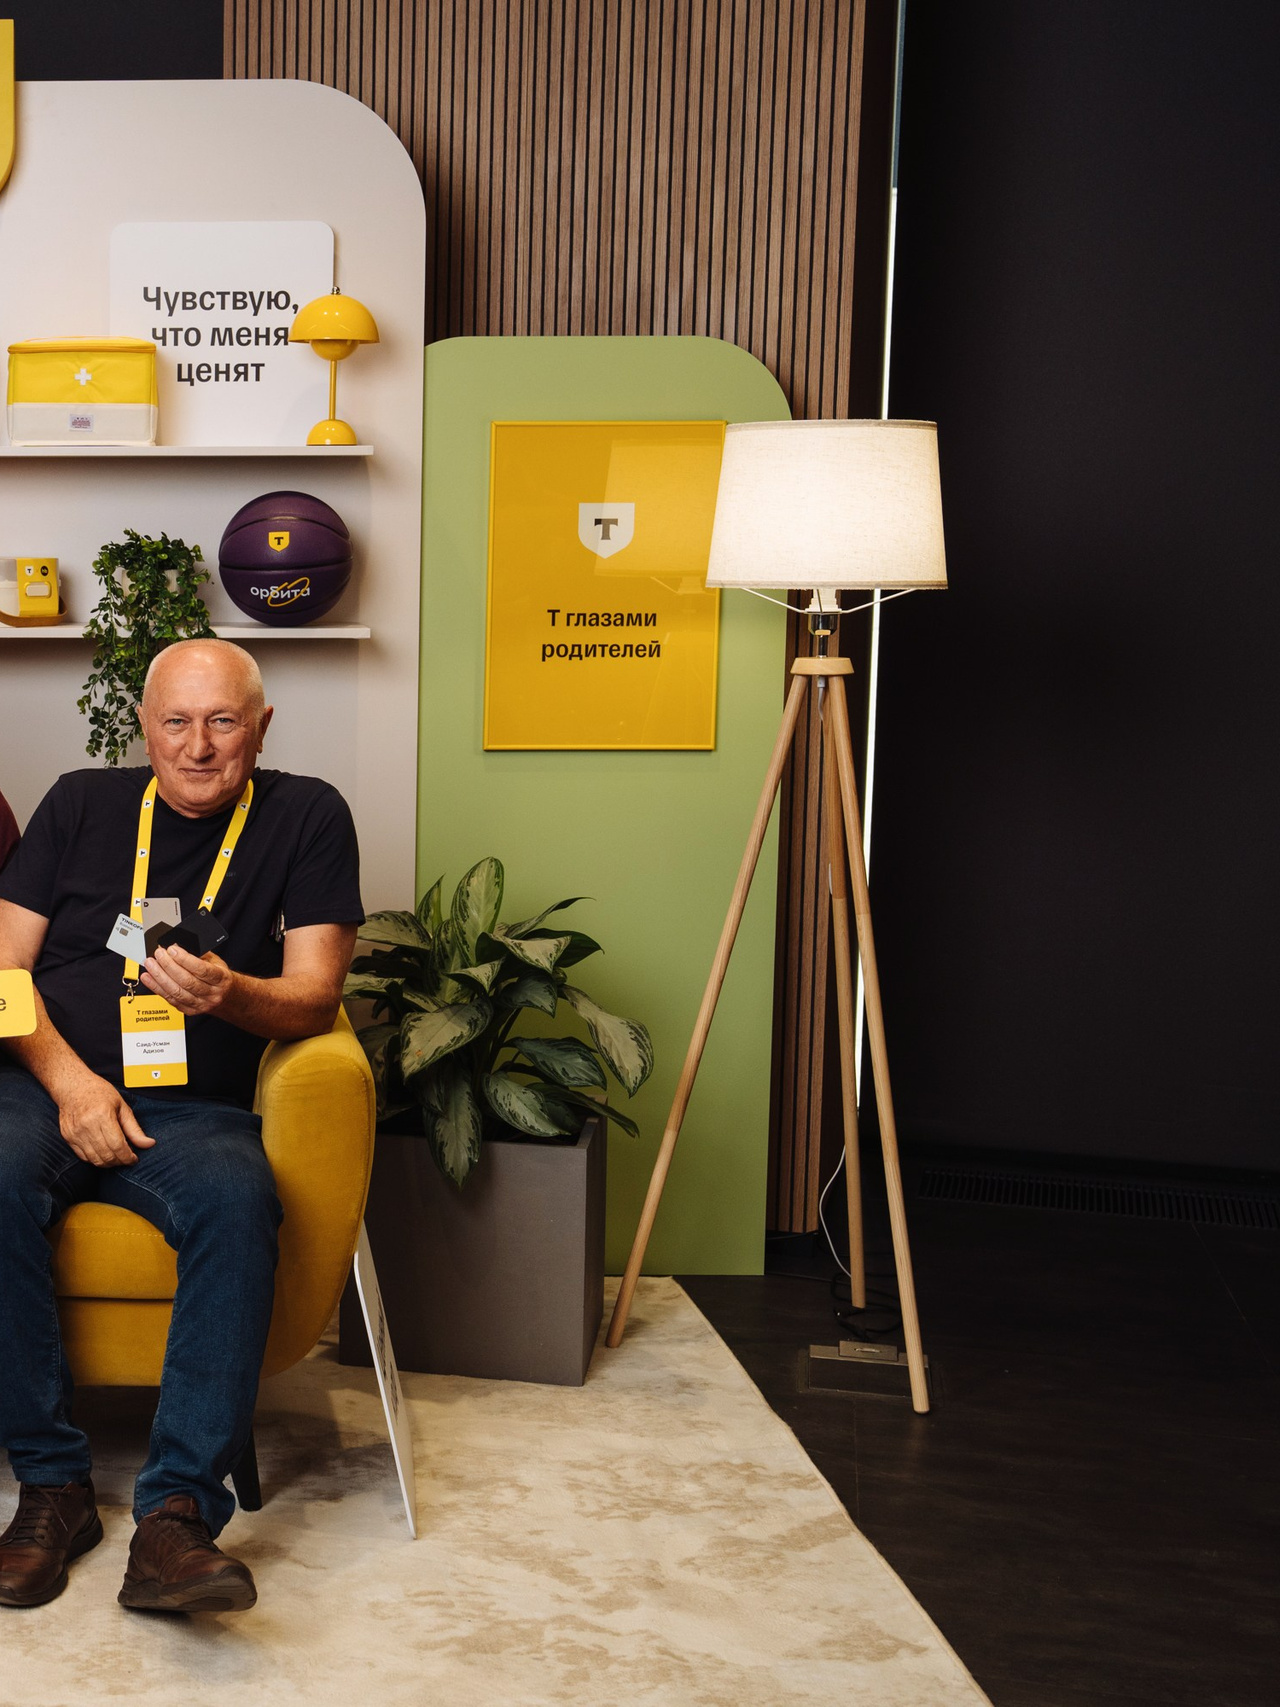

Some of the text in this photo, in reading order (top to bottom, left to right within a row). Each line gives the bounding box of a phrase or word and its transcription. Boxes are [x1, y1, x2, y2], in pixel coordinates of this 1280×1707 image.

[143, 286, 299, 316] Чувствую,
[152, 326, 289, 347] что меня
[177, 363, 265, 387] ценят
[593, 517, 619, 541] Т
[250, 584, 311, 601] орбита
[546, 609, 657, 627] Т глазами
[541, 640, 661, 663] родителей
[135, 1015, 170, 1023] родителей
